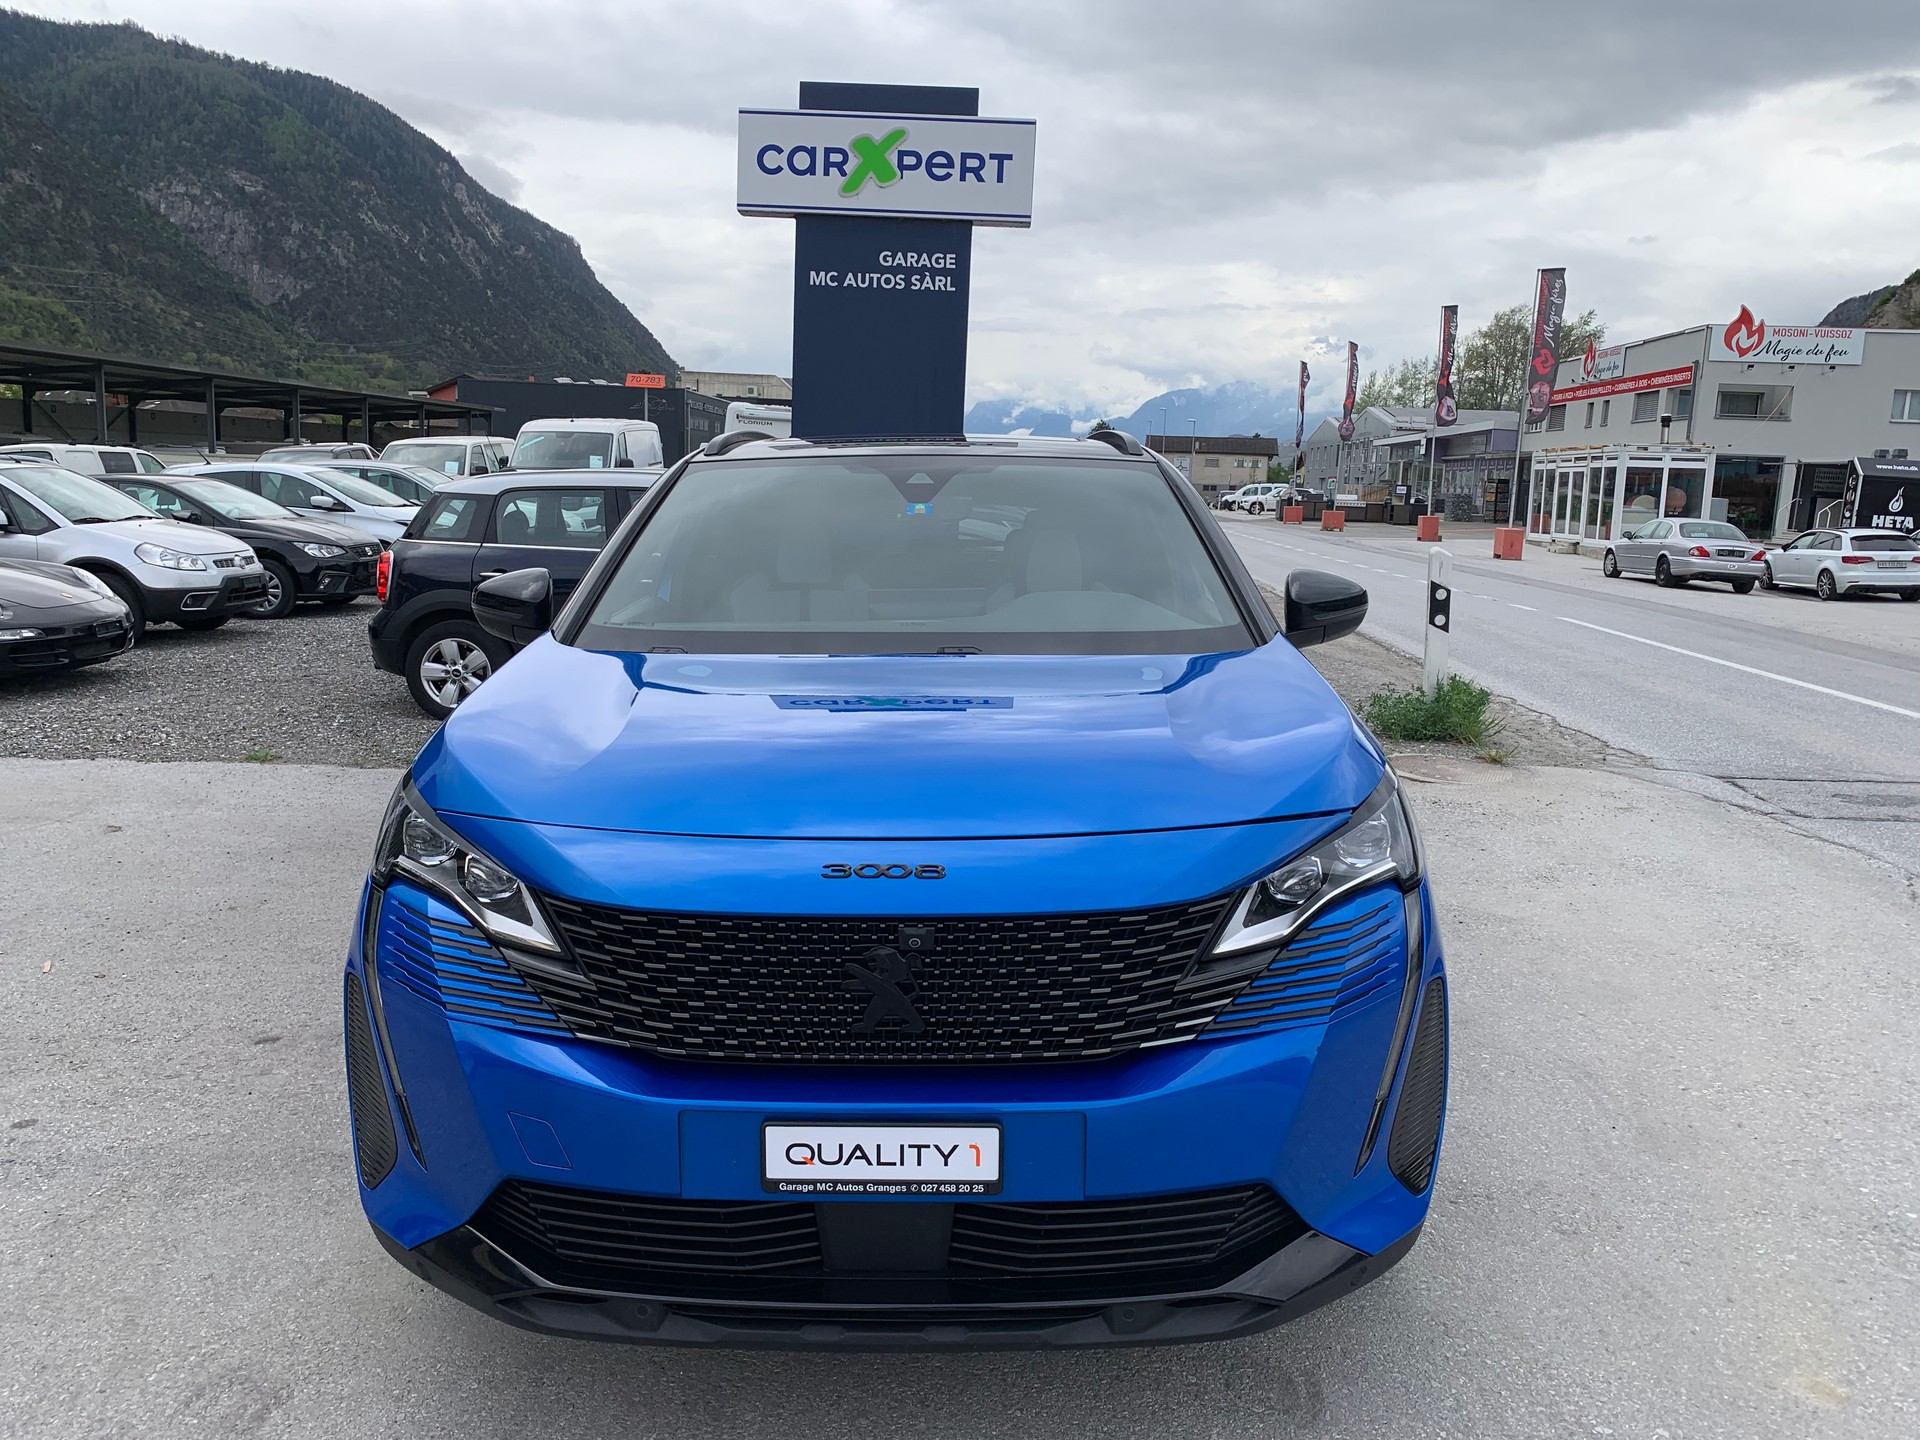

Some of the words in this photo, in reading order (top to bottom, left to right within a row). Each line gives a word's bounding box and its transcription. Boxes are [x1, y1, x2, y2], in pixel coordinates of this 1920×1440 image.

[879, 250, 956, 269] GARAGE
[809, 271, 839, 287] MC
[843, 273, 906, 290] AUTOS
[910, 271, 956, 292] SÀRL
[1772, 327, 1853, 339] MOSONI-VUISSOZ
[1752, 339, 1803, 361] Magie
[1805, 343, 1825, 356] du
[1824, 344, 1849, 362] feu
[630, 375, 661, 384] 70-783
[1871, 514, 1914, 529] HETA
[820, 863, 947, 880] 3008
[785, 1142, 960, 1167] QUALITY
[969, 1144, 981, 1167] 1
[779, 1182, 814, 1192] Garage
[816, 1183, 834, 1191] MC
[836, 1183, 864, 1192] Autos
[866, 1183, 907, 1193] Granges
[920, 1184, 938, 1192] 027
[939, 1184, 956, 1192] 458
[958, 1184, 970, 1192] 20
[972, 1184, 984, 1192] 25
